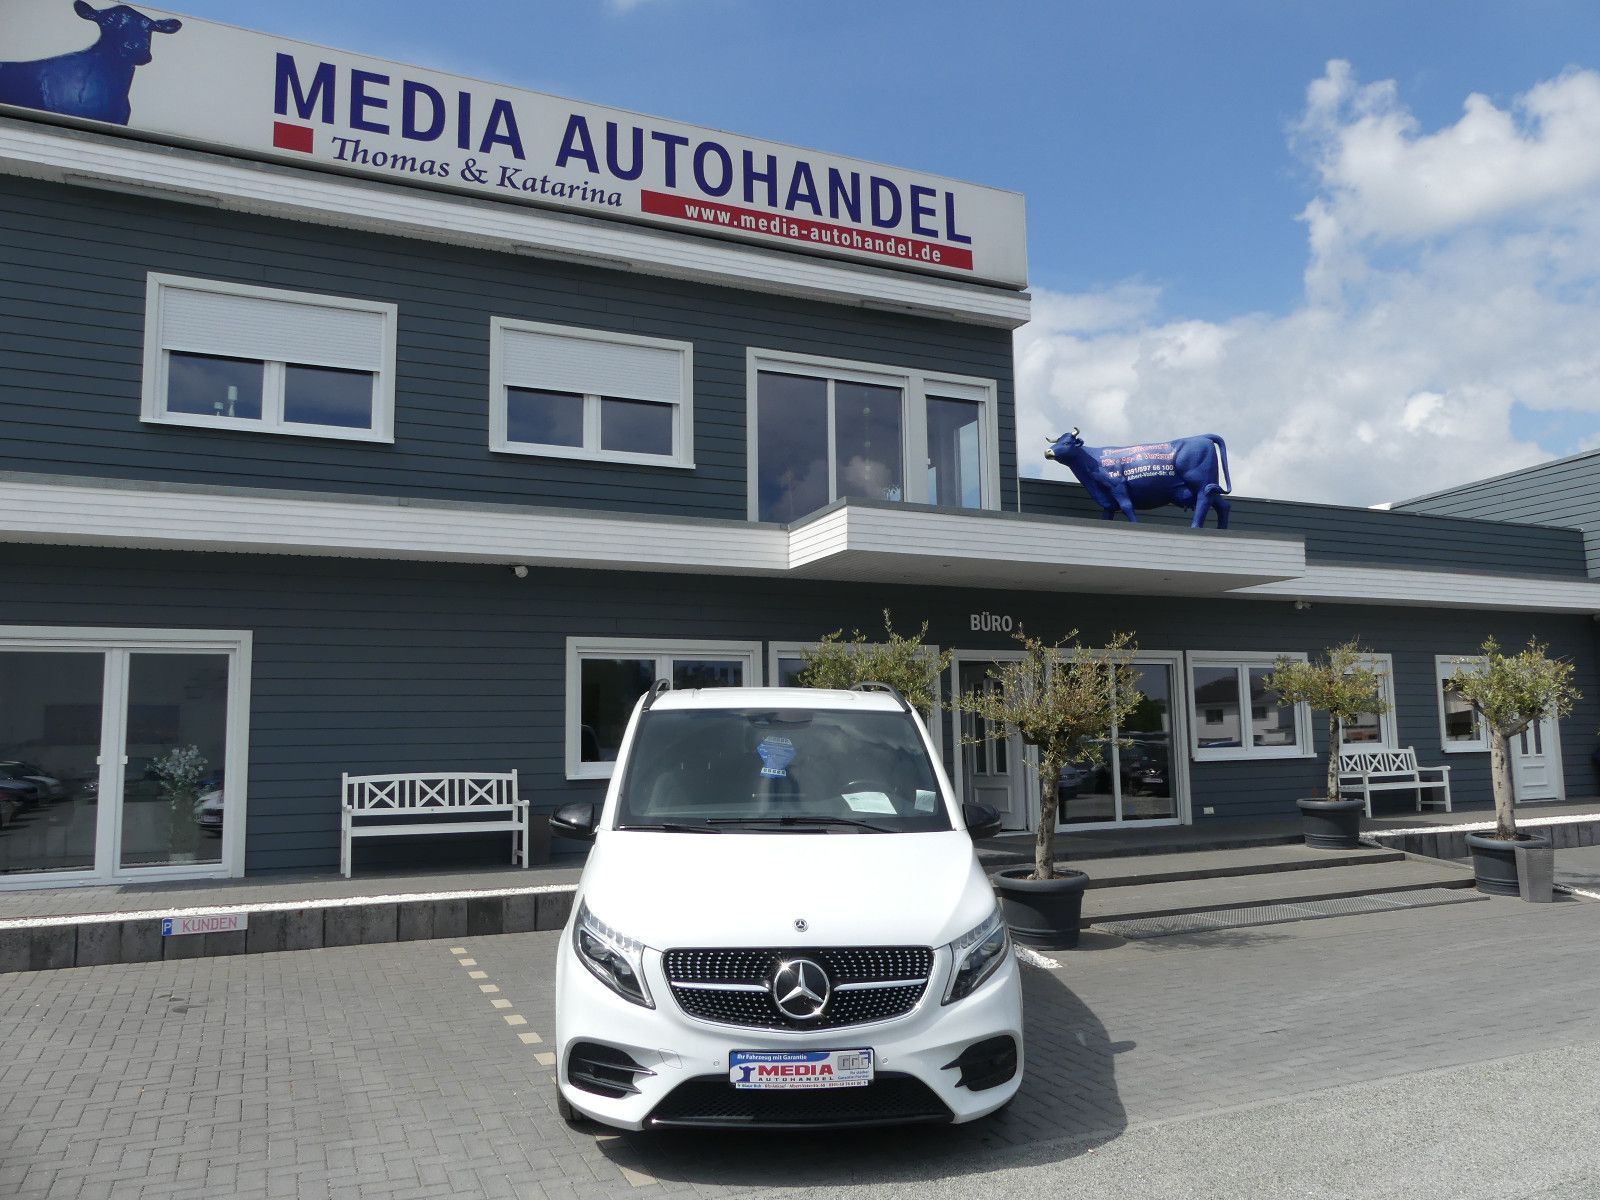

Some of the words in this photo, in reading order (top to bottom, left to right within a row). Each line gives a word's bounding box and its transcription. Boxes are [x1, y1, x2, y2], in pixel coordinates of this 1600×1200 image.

[274, 52, 526, 161] MEDIA
[555, 113, 972, 245] AUTOHANDEL
[331, 136, 451, 178] Thomas
[460, 158, 489, 185] &
[496, 165, 623, 207] Katarina
[684, 202, 942, 263] www.media-autohandel.de
[970, 611, 1013, 632] BÜRO
[164, 922, 172, 932] P
[182, 916, 238, 933] KUNDEN
[745, 1053, 772, 1062] Fahrzeug
[782, 1053, 808, 1061] Garantie
[758, 1064, 834, 1077] MEDIA
